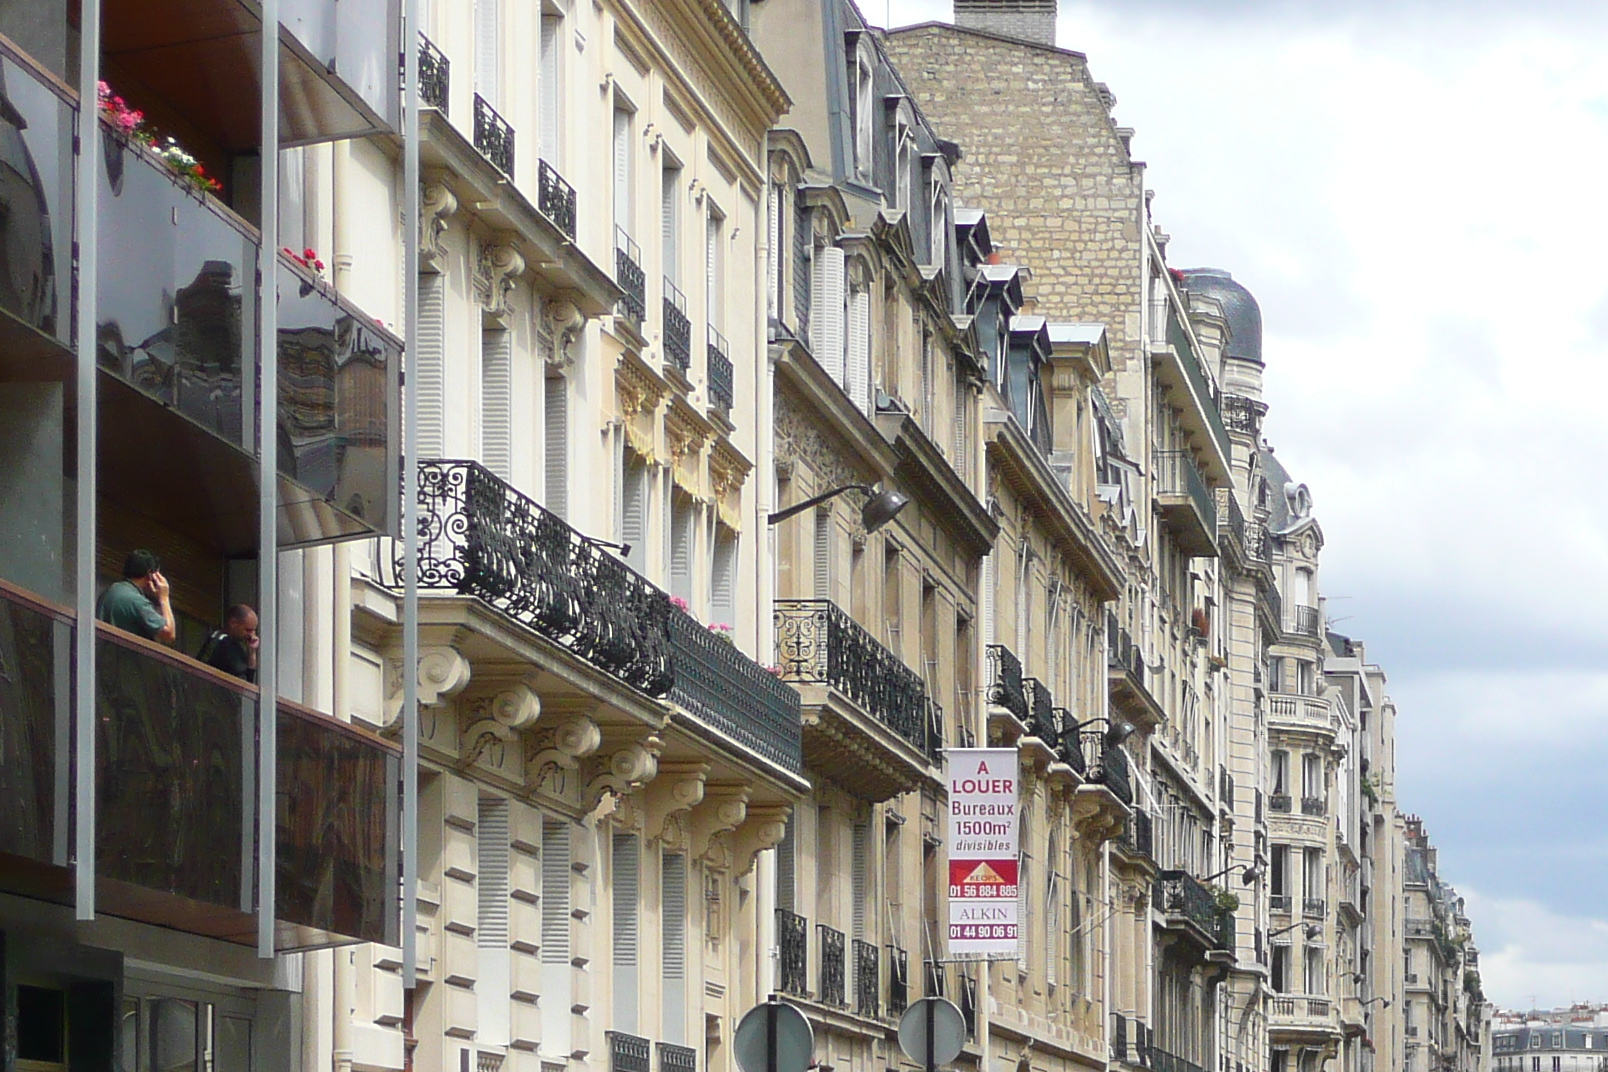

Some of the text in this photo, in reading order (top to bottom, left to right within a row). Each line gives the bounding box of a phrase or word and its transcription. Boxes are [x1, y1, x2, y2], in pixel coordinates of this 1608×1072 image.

[977, 760, 990, 775] A
[953, 779, 1013, 794] LOUER
[952, 800, 1014, 816] Bureaux
[956, 840, 1011, 852] divisibles
[950, 885, 961, 897] 01
[964, 885, 977, 897] 56
[960, 908, 1008, 920] ALKIN
[950, 925, 1018, 938] 01 44 90 06 91
